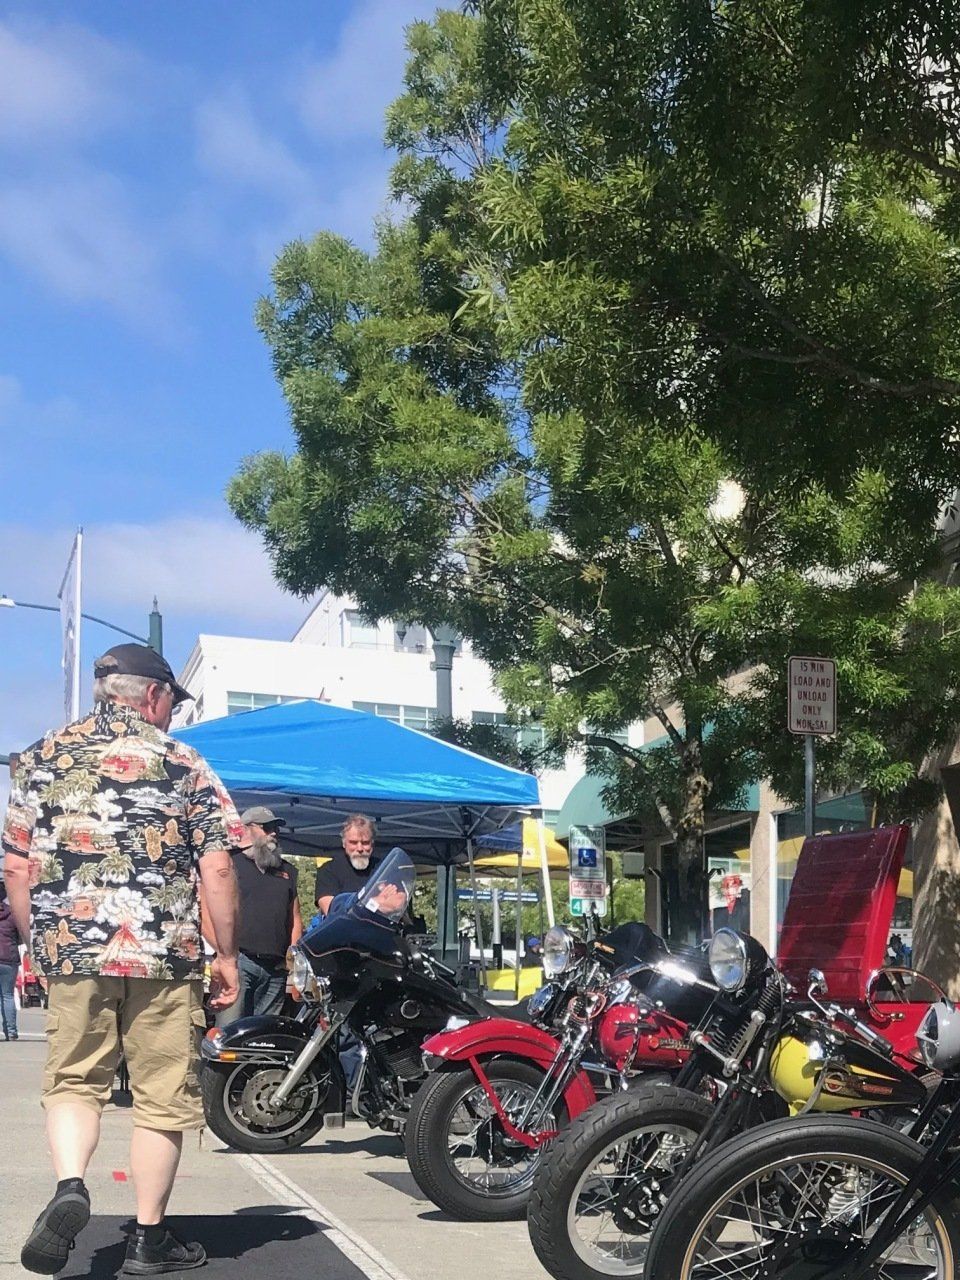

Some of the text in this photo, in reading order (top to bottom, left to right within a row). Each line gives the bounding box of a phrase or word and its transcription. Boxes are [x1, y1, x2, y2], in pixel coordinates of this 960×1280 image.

[800, 662, 824, 672] 15 MIN
[794, 676, 830, 688] LOAD AND
[797, 691, 827, 702] UNLOAD
[802, 705, 821, 715] ONLY
